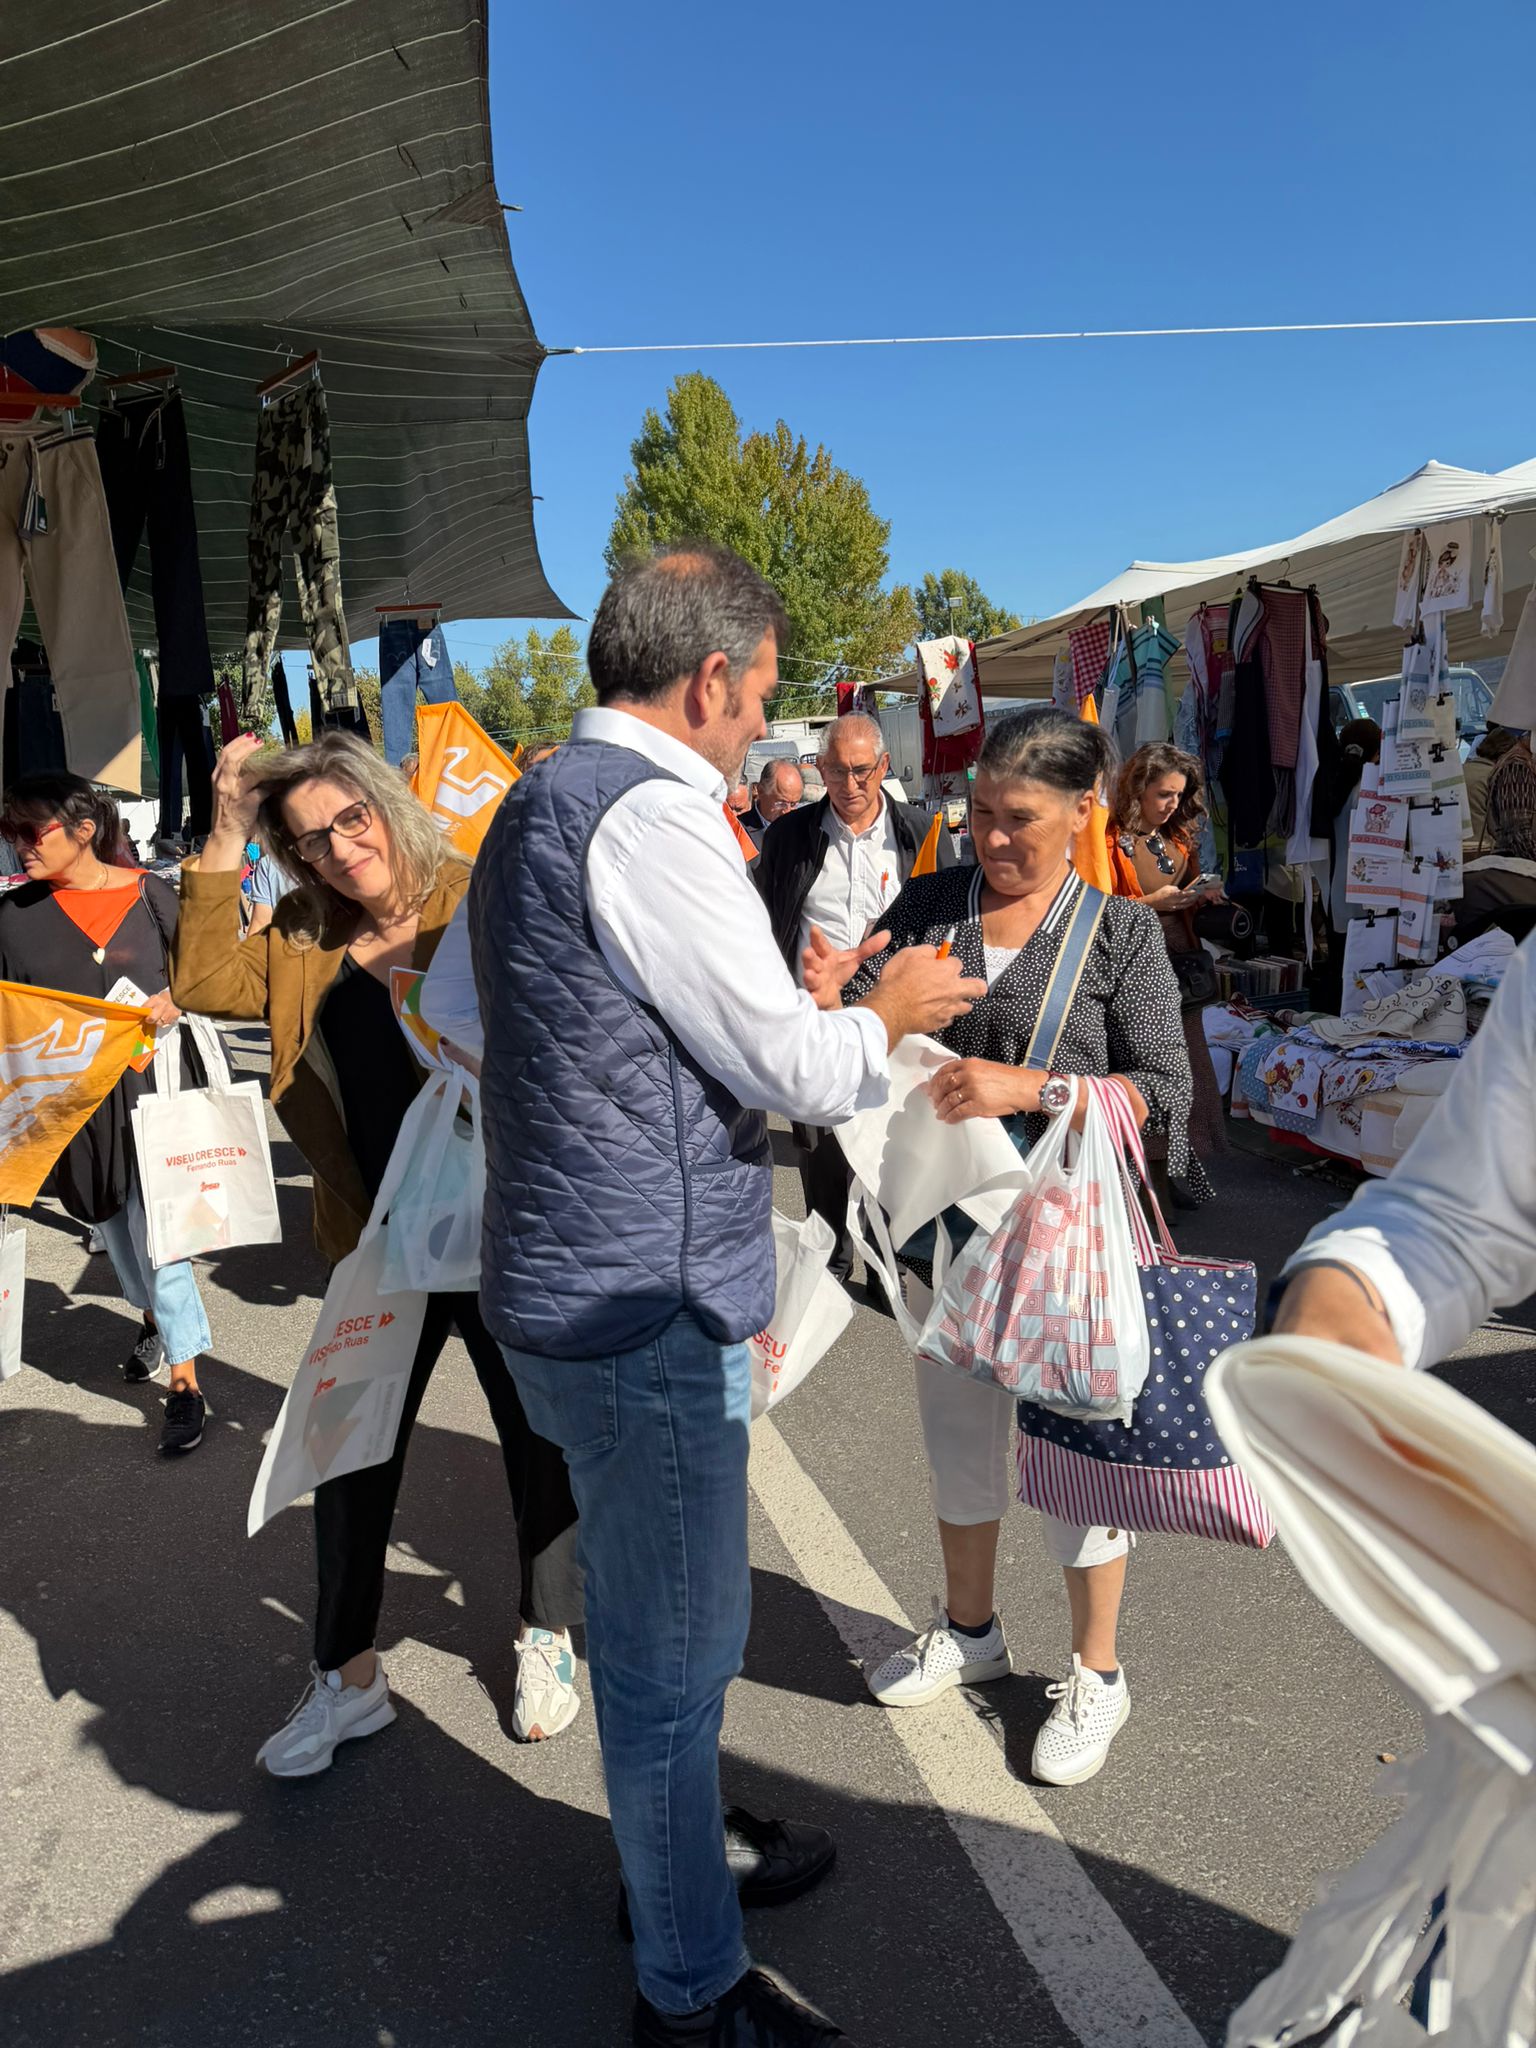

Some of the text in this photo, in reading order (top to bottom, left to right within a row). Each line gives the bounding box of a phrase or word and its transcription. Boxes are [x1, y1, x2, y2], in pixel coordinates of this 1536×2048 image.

[165, 1147, 236, 1167] VISEU CRESCE
[218, 1158, 237, 1167] Ruas
[335, 1314, 375, 1338] ESCE
[344, 1335, 369, 1349] Ruas
[753, 1329, 787, 1358] SEU
